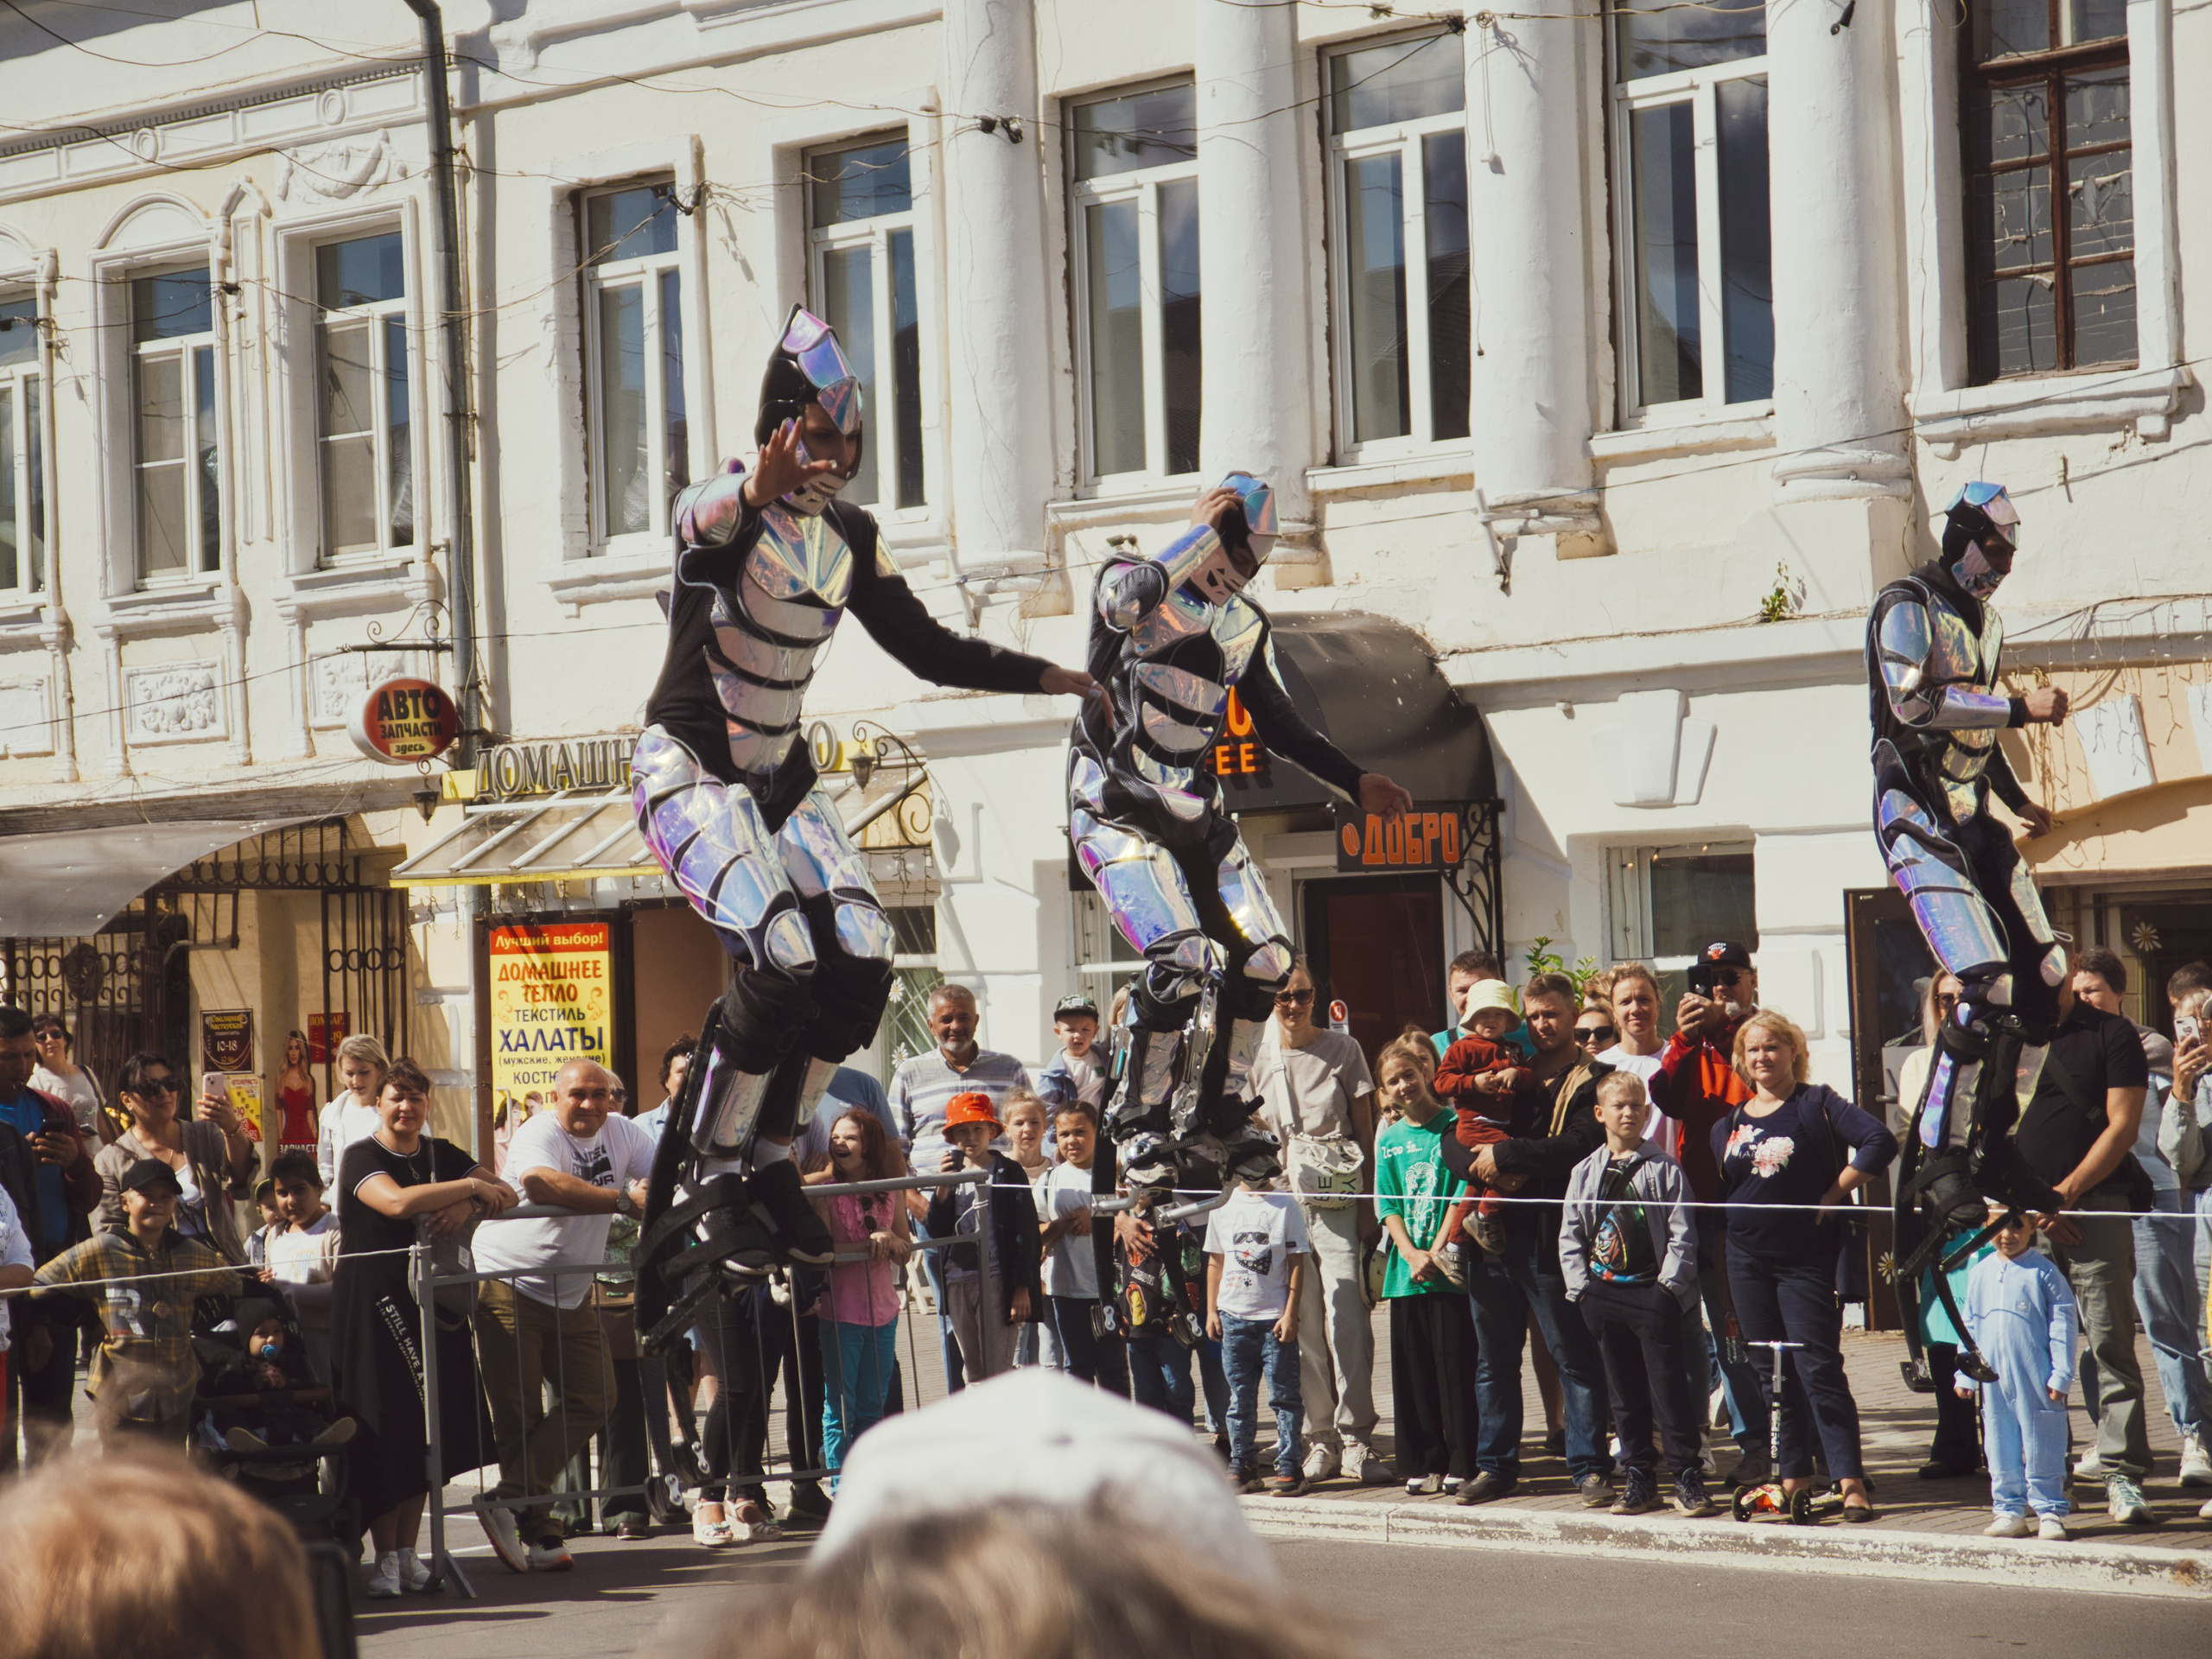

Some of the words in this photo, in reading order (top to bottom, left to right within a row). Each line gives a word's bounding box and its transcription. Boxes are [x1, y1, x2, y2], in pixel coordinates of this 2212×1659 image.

[378, 687, 441, 721] АВТО
[380, 721, 442, 739] ЗАПЧАСТИ
[395, 743, 425, 754] здесь
[1363, 812, 1459, 864] ДОБРО
[495, 932, 550, 949] Лучший
[553, 931, 603, 947] выбор!
[498, 960, 602, 982] ДОМАШНЕЕ
[522, 982, 578, 1002] ТЕПЛО
[514, 1007, 586, 1022] ТЕКСТИЛЬ
[216, 1039, 238, 1052] 10-18
[499, 1026, 603, 1052] ХАЛАТЫ
[1381, 1145, 1404, 1160] love
[385, 1304, 407, 1336] STILL
[404, 1337, 421, 1369] HAVE
